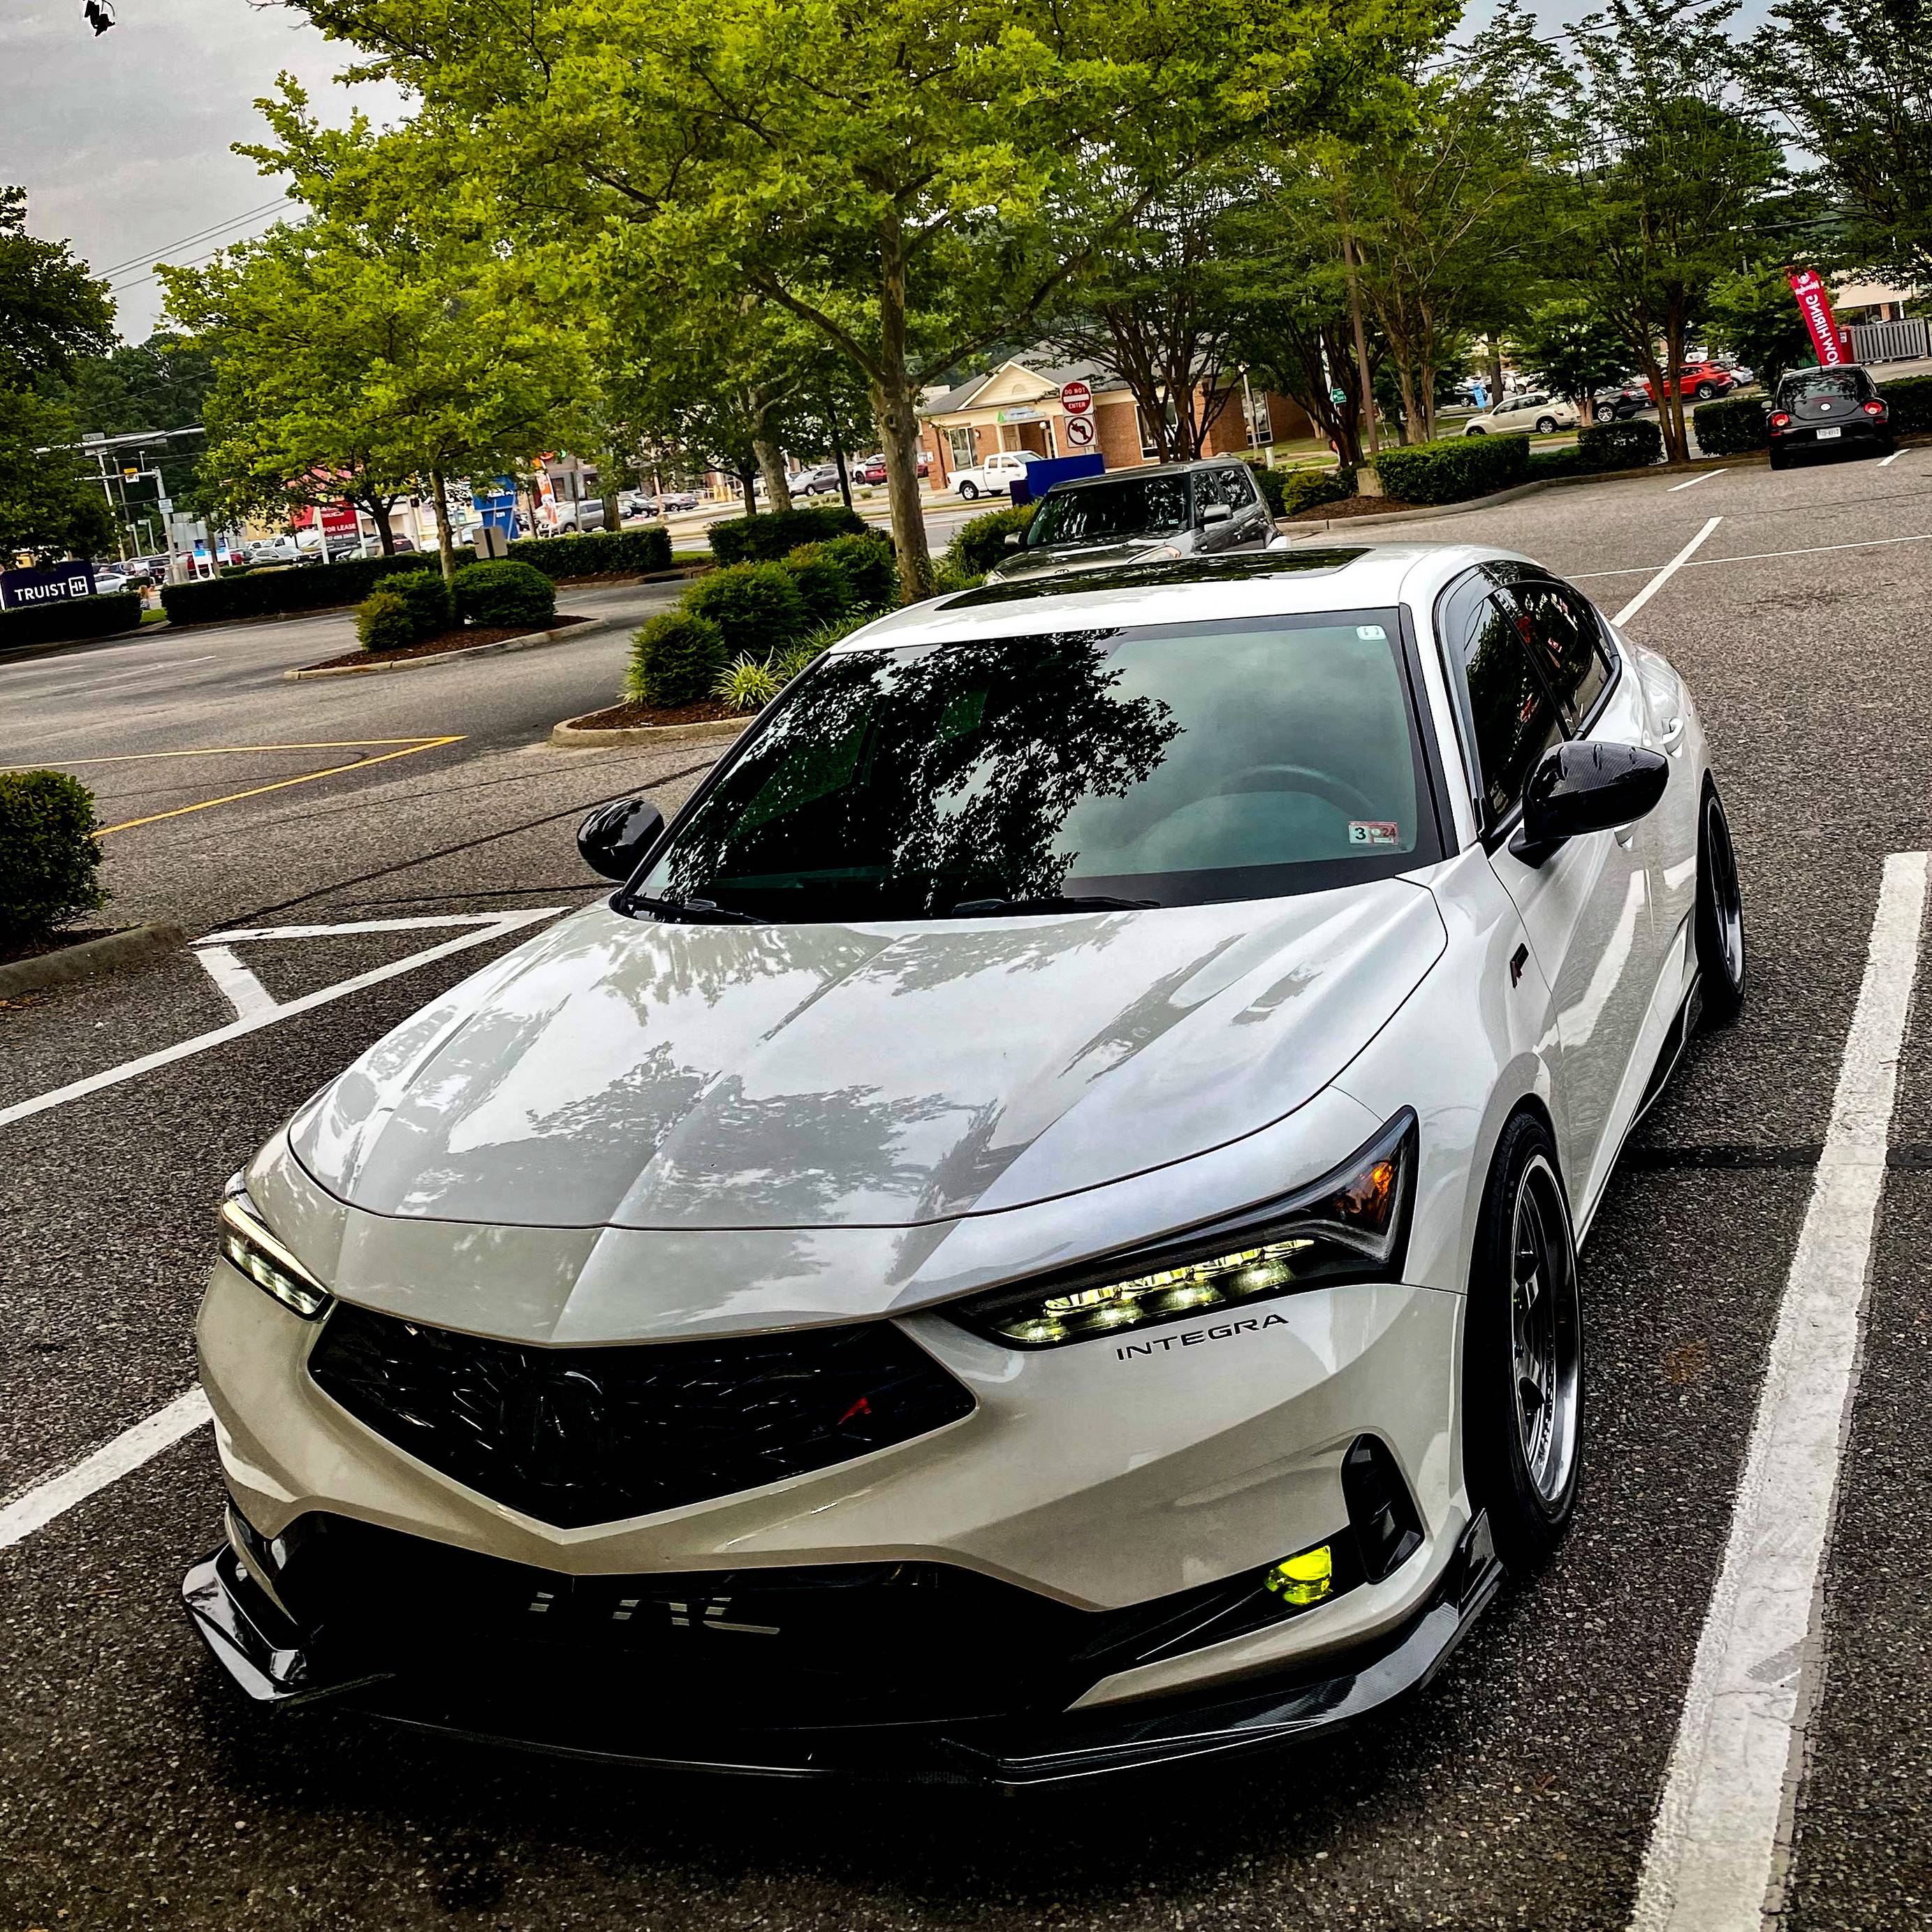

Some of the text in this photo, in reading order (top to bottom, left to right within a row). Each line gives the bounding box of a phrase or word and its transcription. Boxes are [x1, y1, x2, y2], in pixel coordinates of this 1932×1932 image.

[1069, 401, 1086, 409] ENTER
[14, 583, 66, 601] TRUIST
[1354, 827, 1366, 840] 3
[1382, 827, 1396, 837] 24
[1115, 1314, 1289, 1361] INTEGRA
